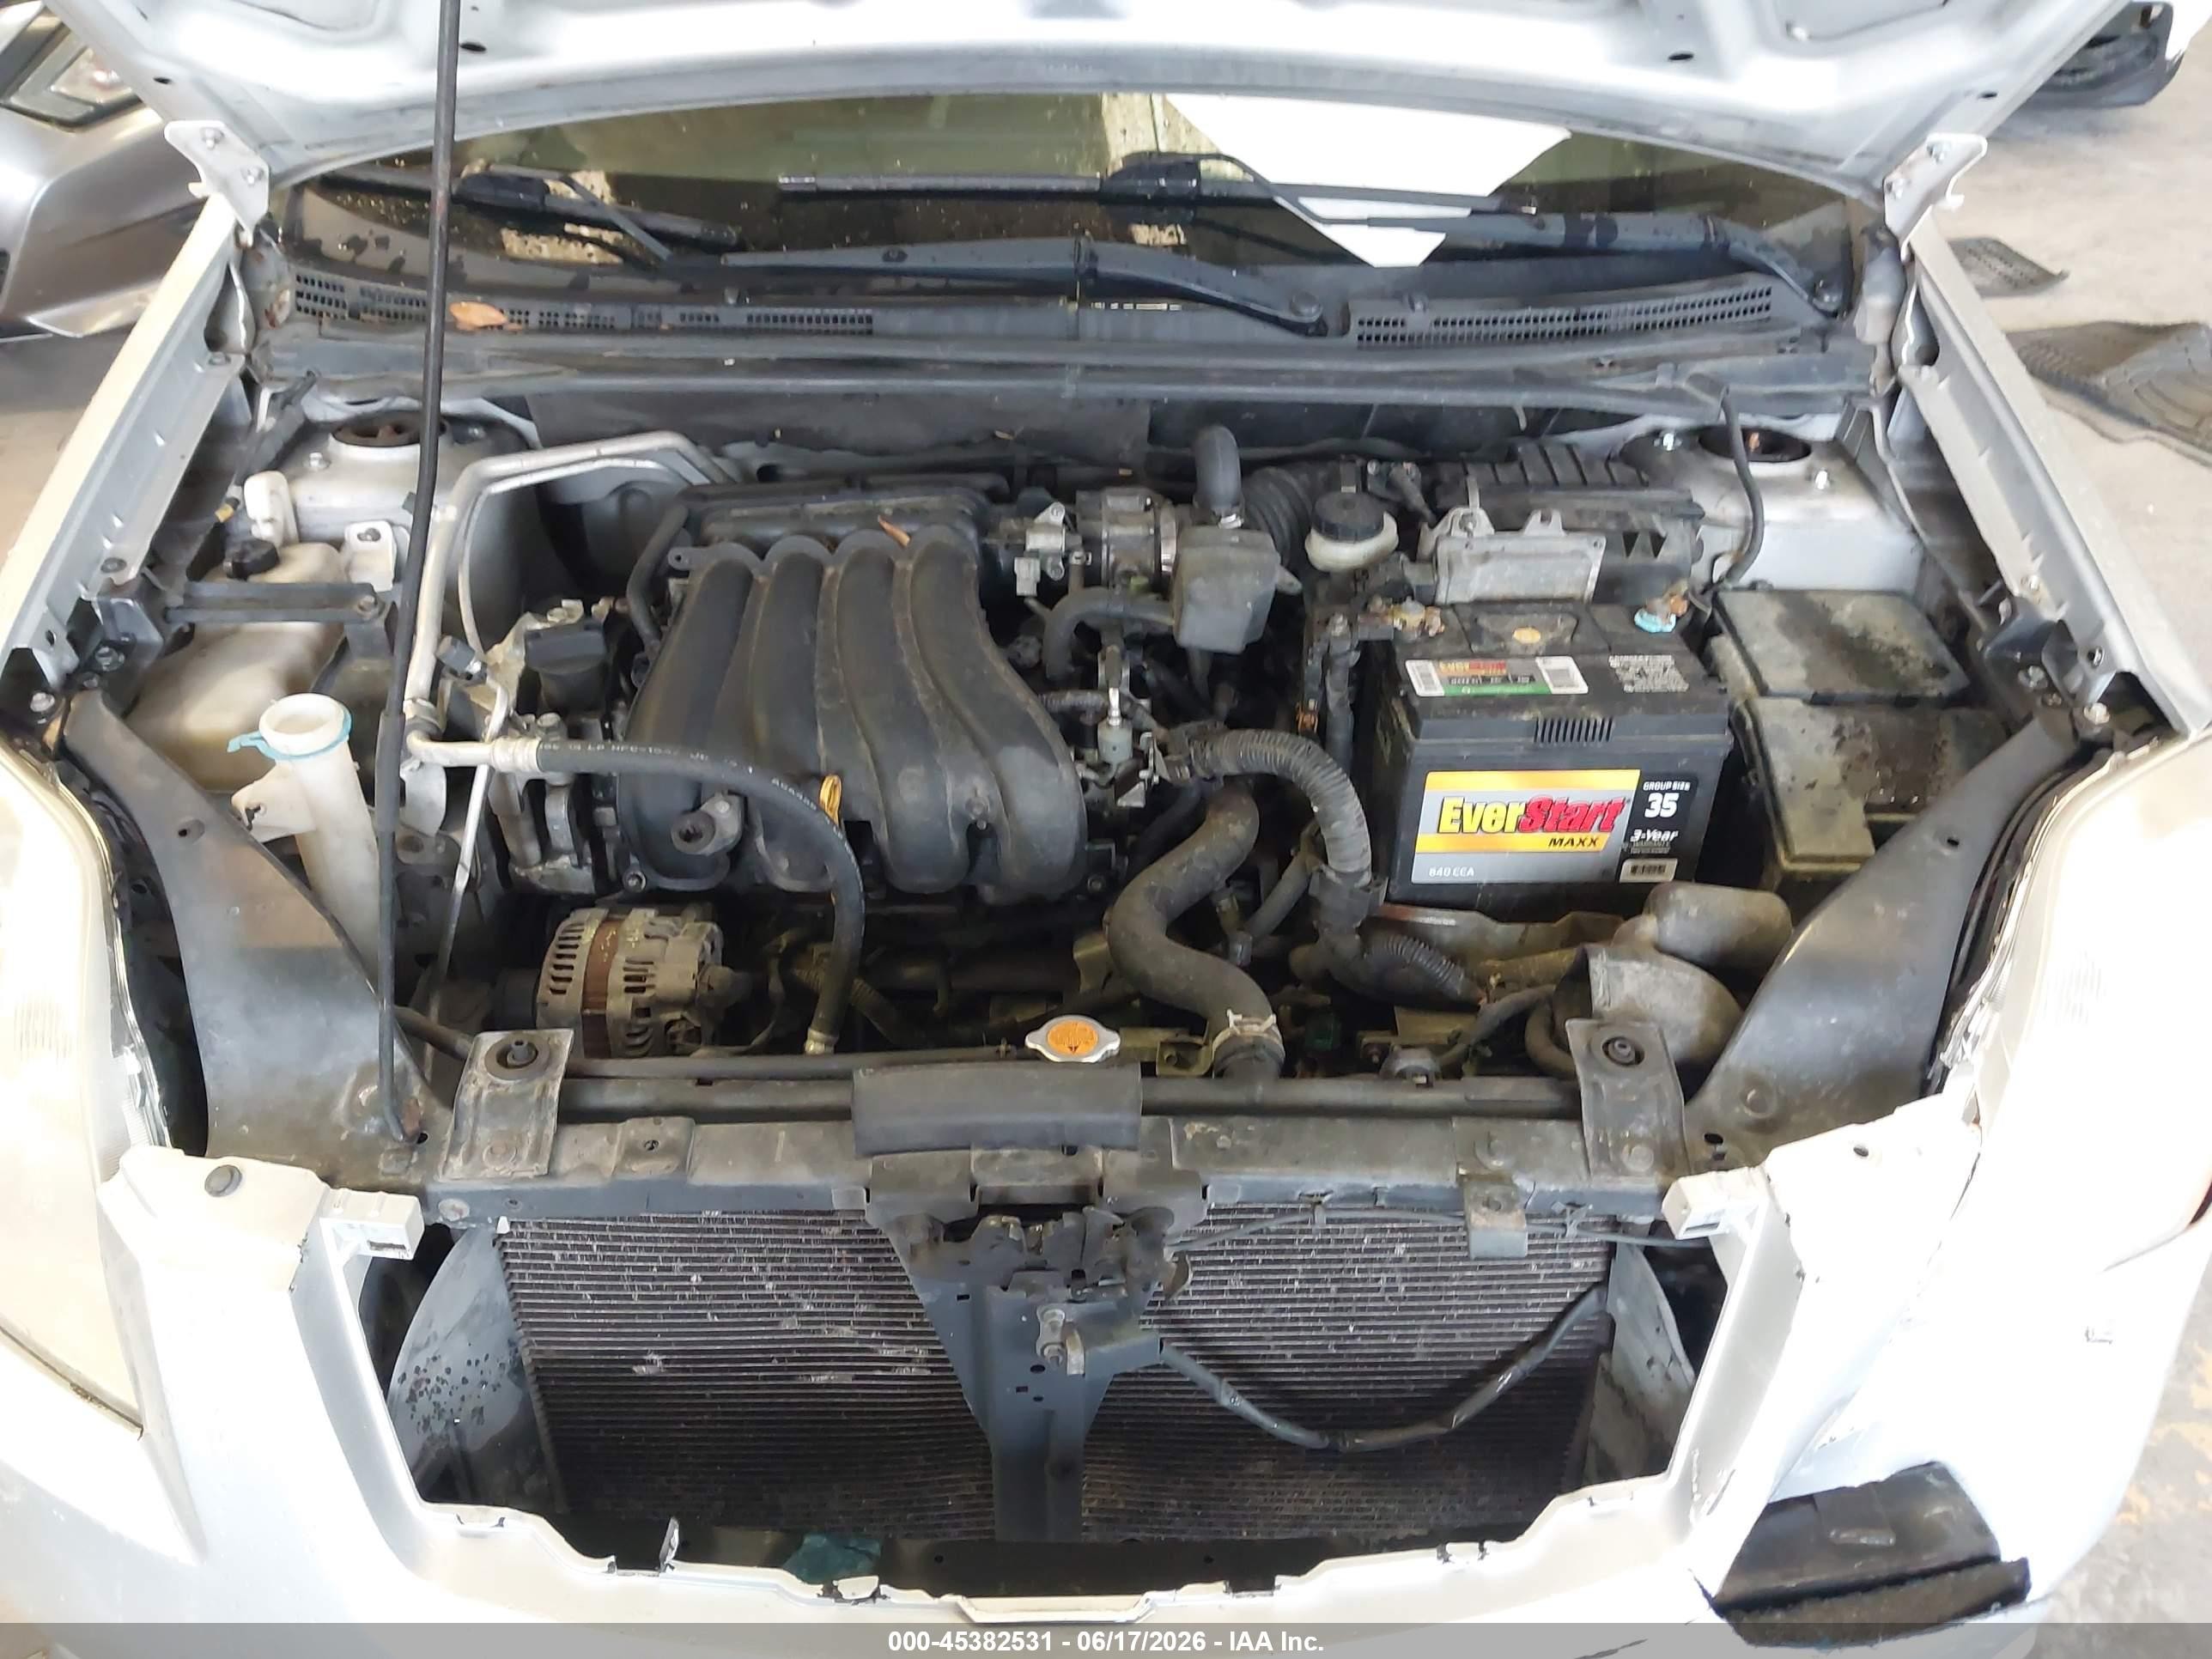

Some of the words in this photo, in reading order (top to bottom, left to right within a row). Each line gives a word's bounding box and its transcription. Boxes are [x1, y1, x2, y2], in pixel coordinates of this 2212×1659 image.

[1643, 781, 1672, 791] GROUP
[1644, 792, 1680, 818] 35
[1437, 794, 1626, 834] EverStart
[1630, 829, 1679, 842] 3-Year
[1548, 837, 1599, 848] MAXX
